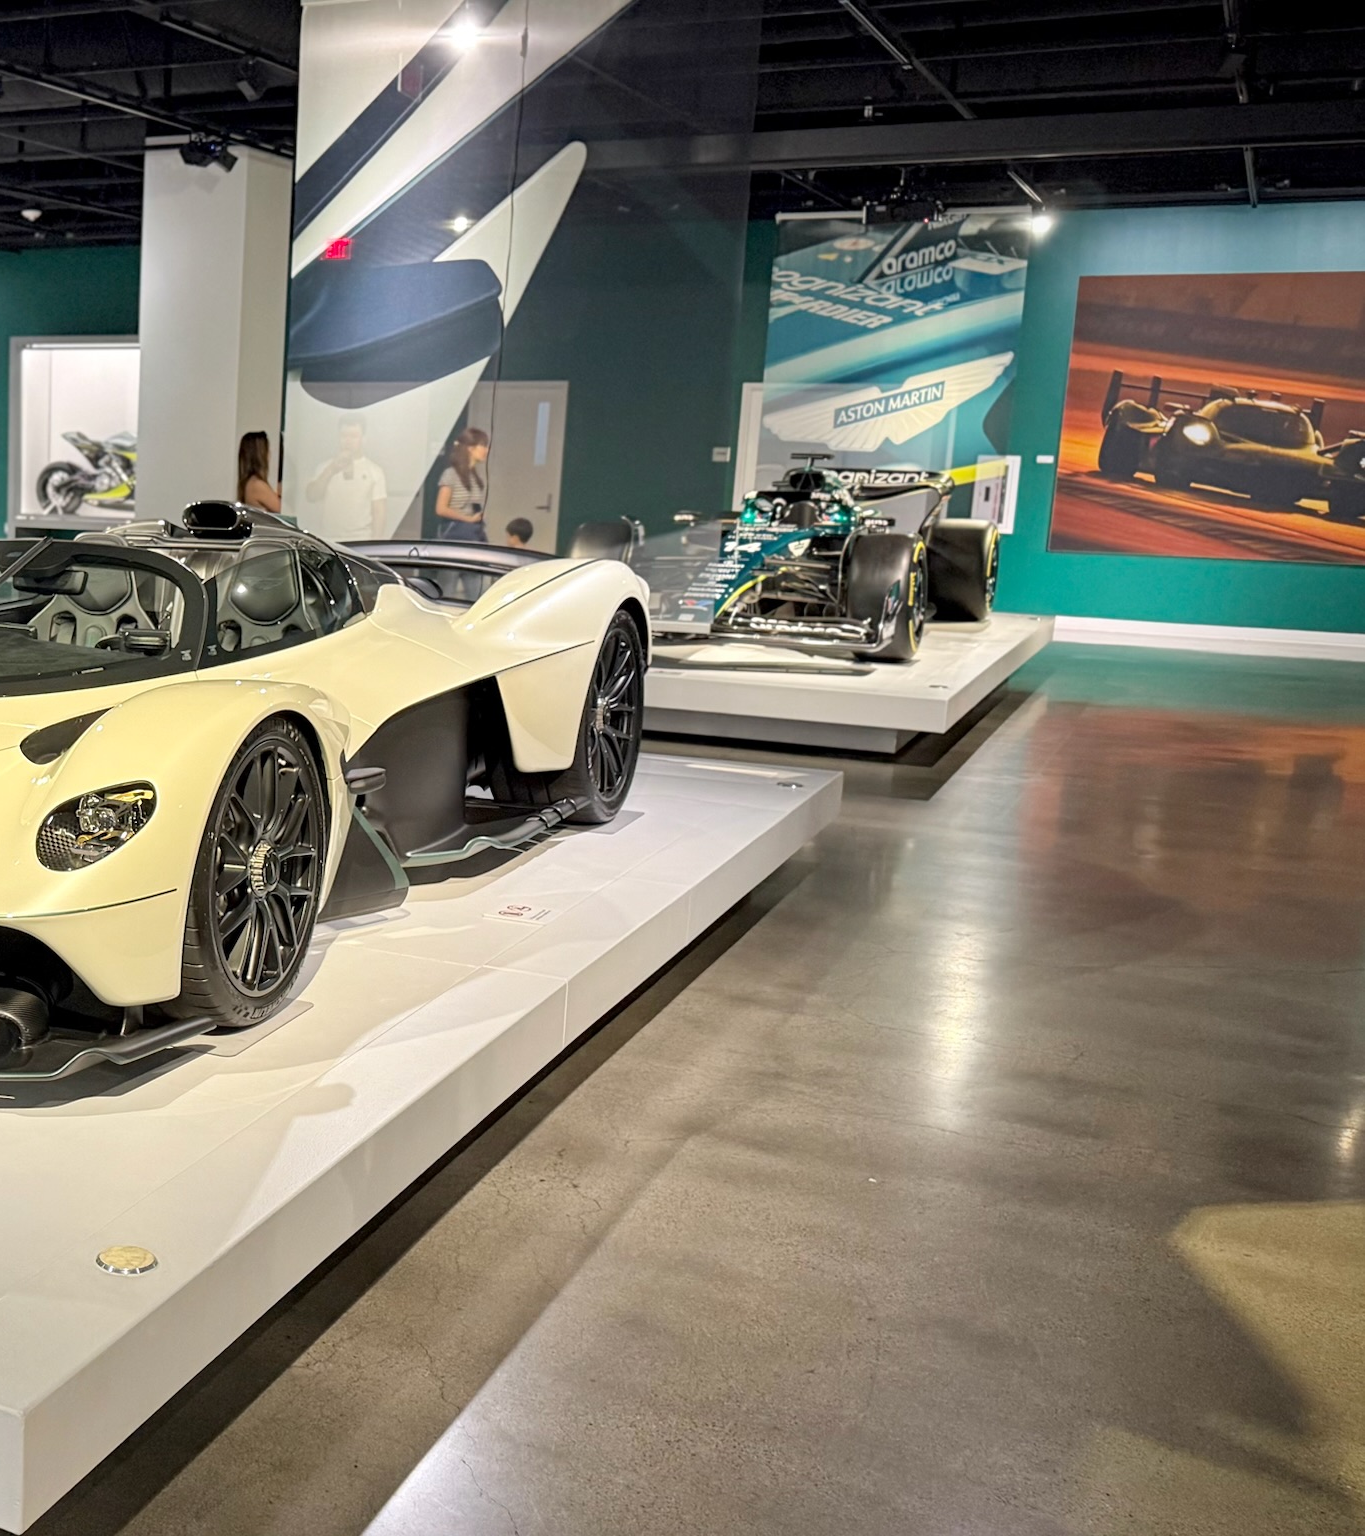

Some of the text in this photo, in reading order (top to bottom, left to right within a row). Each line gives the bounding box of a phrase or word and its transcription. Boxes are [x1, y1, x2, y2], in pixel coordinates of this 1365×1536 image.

[882, 239, 956, 275] aramco
[772, 267, 944, 316] ognizant
[836, 384, 943, 425] ASTON MARTIN
